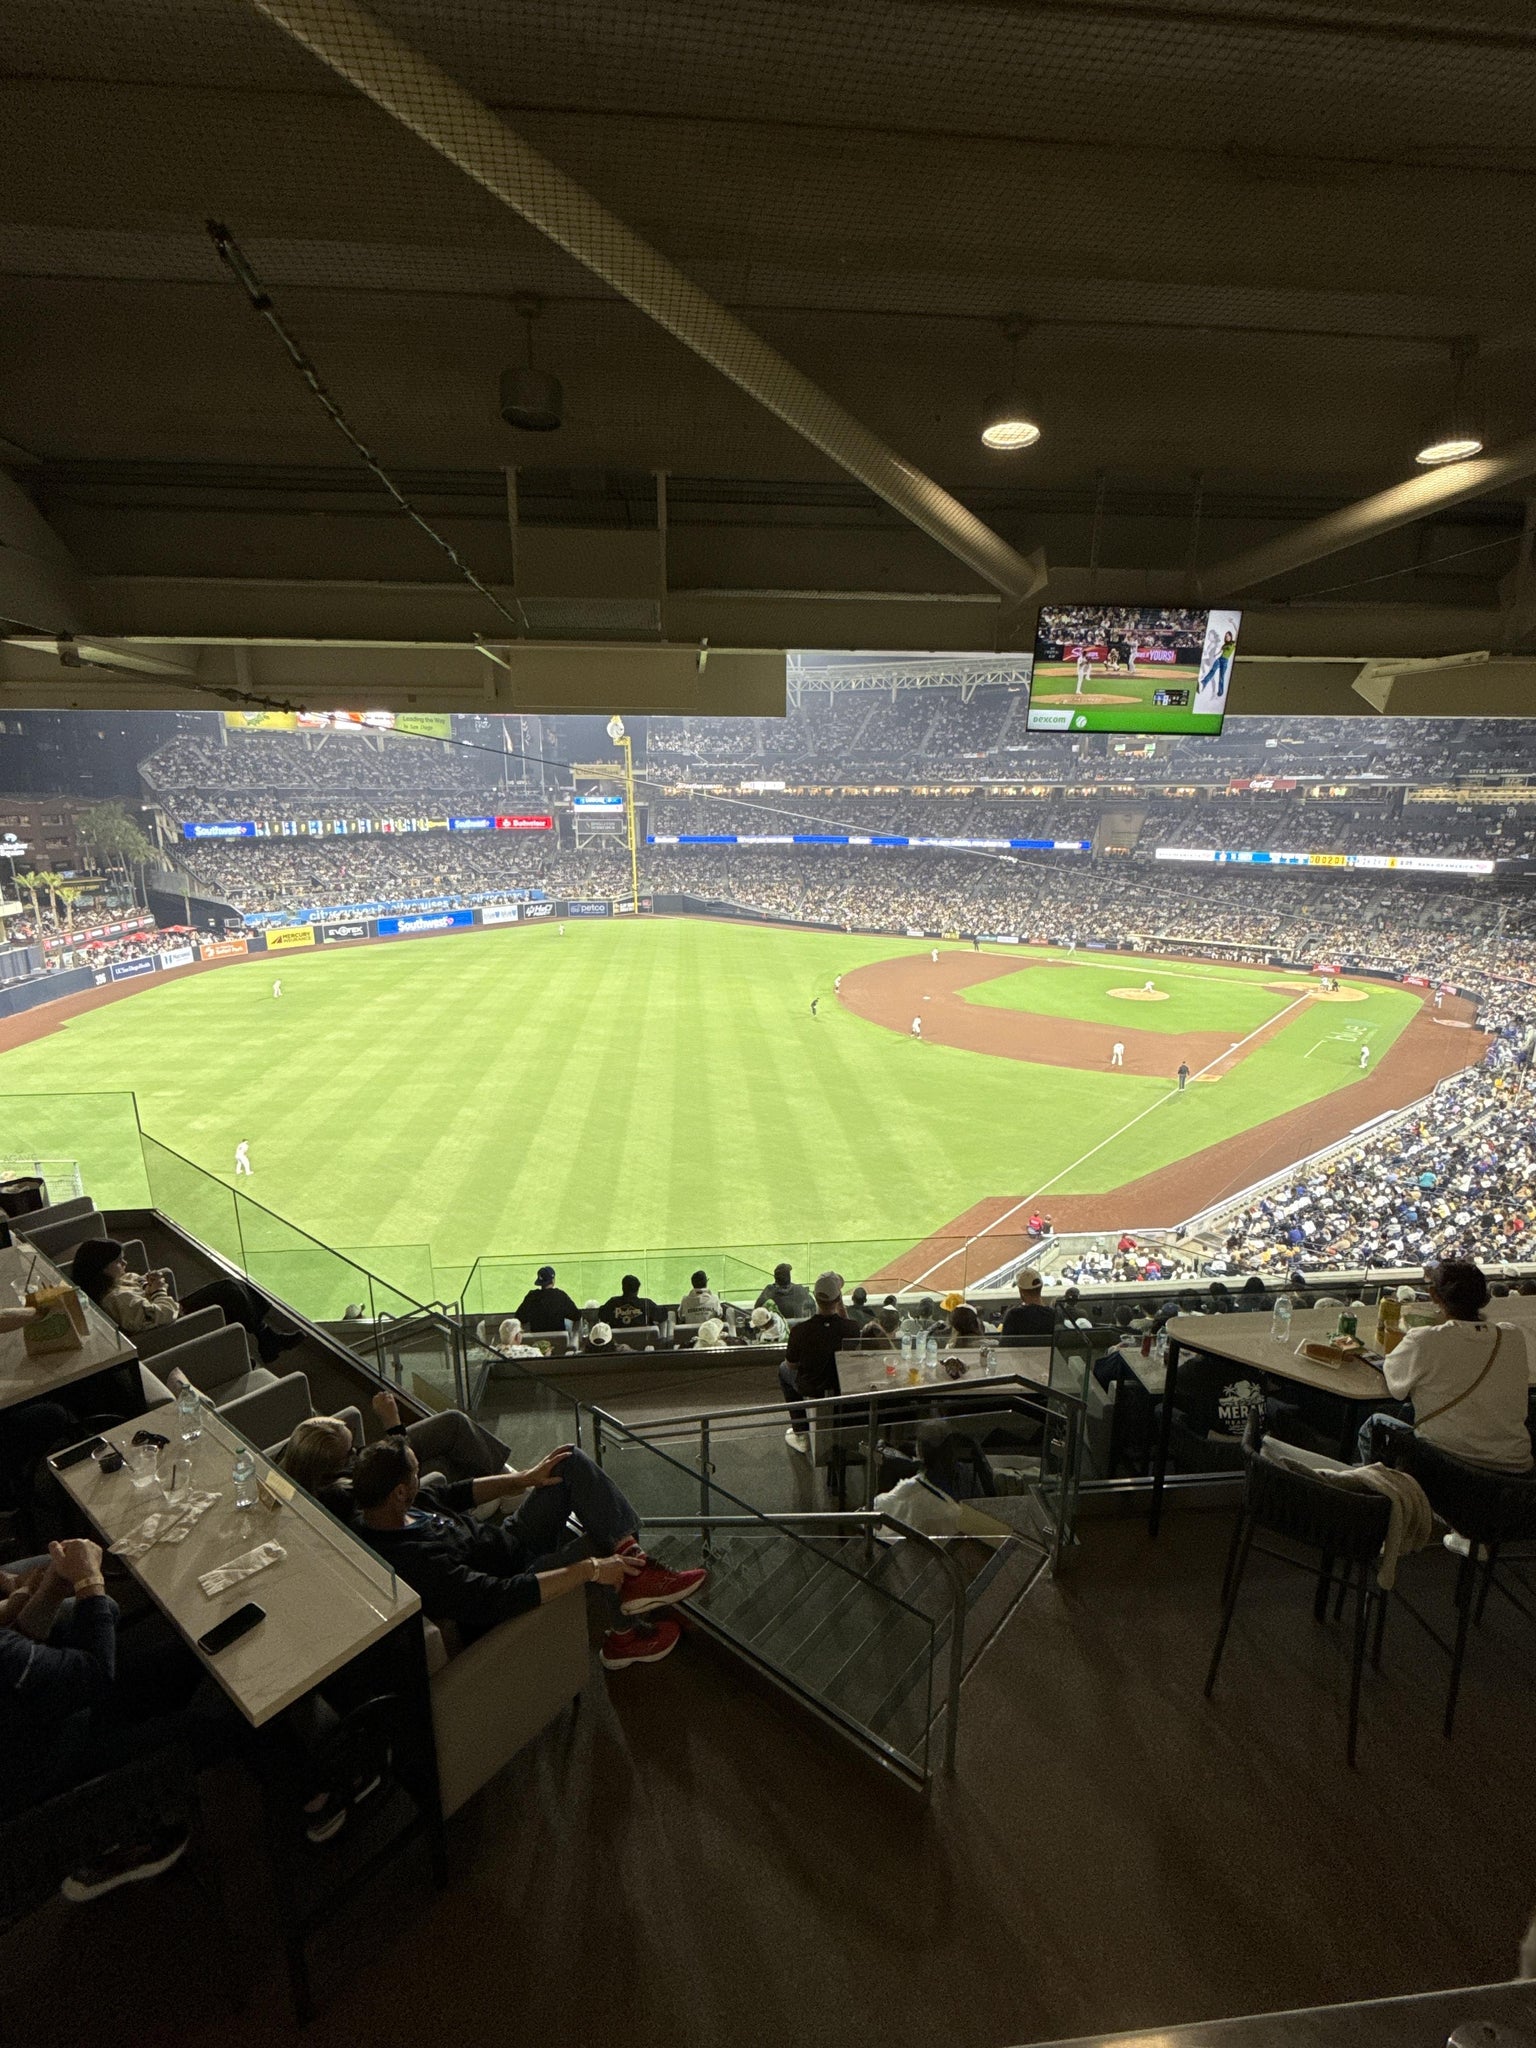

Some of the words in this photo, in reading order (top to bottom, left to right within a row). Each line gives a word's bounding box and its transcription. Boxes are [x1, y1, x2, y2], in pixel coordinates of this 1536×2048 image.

[194, 826, 241, 837] Southwest
[580, 903, 605, 912] petco
[397, 916, 449, 932] Southwest
[282, 931, 310, 939] MERCURY
[1218, 1404, 1267, 1419] MERKI
